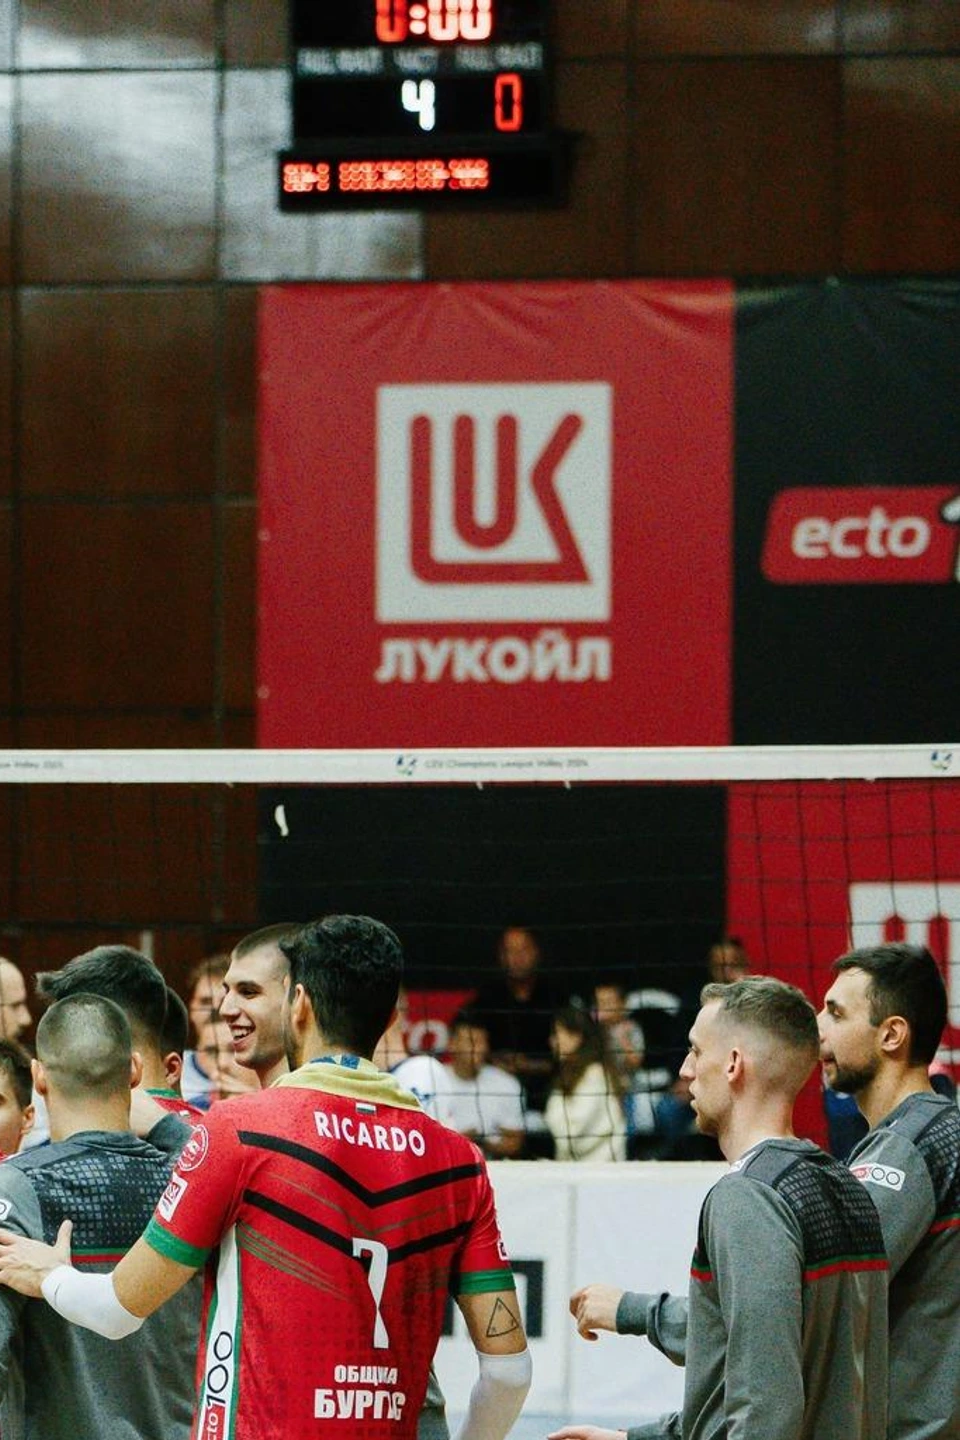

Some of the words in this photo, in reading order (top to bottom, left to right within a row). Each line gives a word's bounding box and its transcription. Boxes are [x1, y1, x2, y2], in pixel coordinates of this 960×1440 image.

[401, 79, 436, 132] 4
[494, 73, 523, 132] 0
[375, 630, 612, 683] ЛУКОЙЛ
[313, 1111, 426, 1157] RICARDO
[352, 1237, 389, 1349] 7
